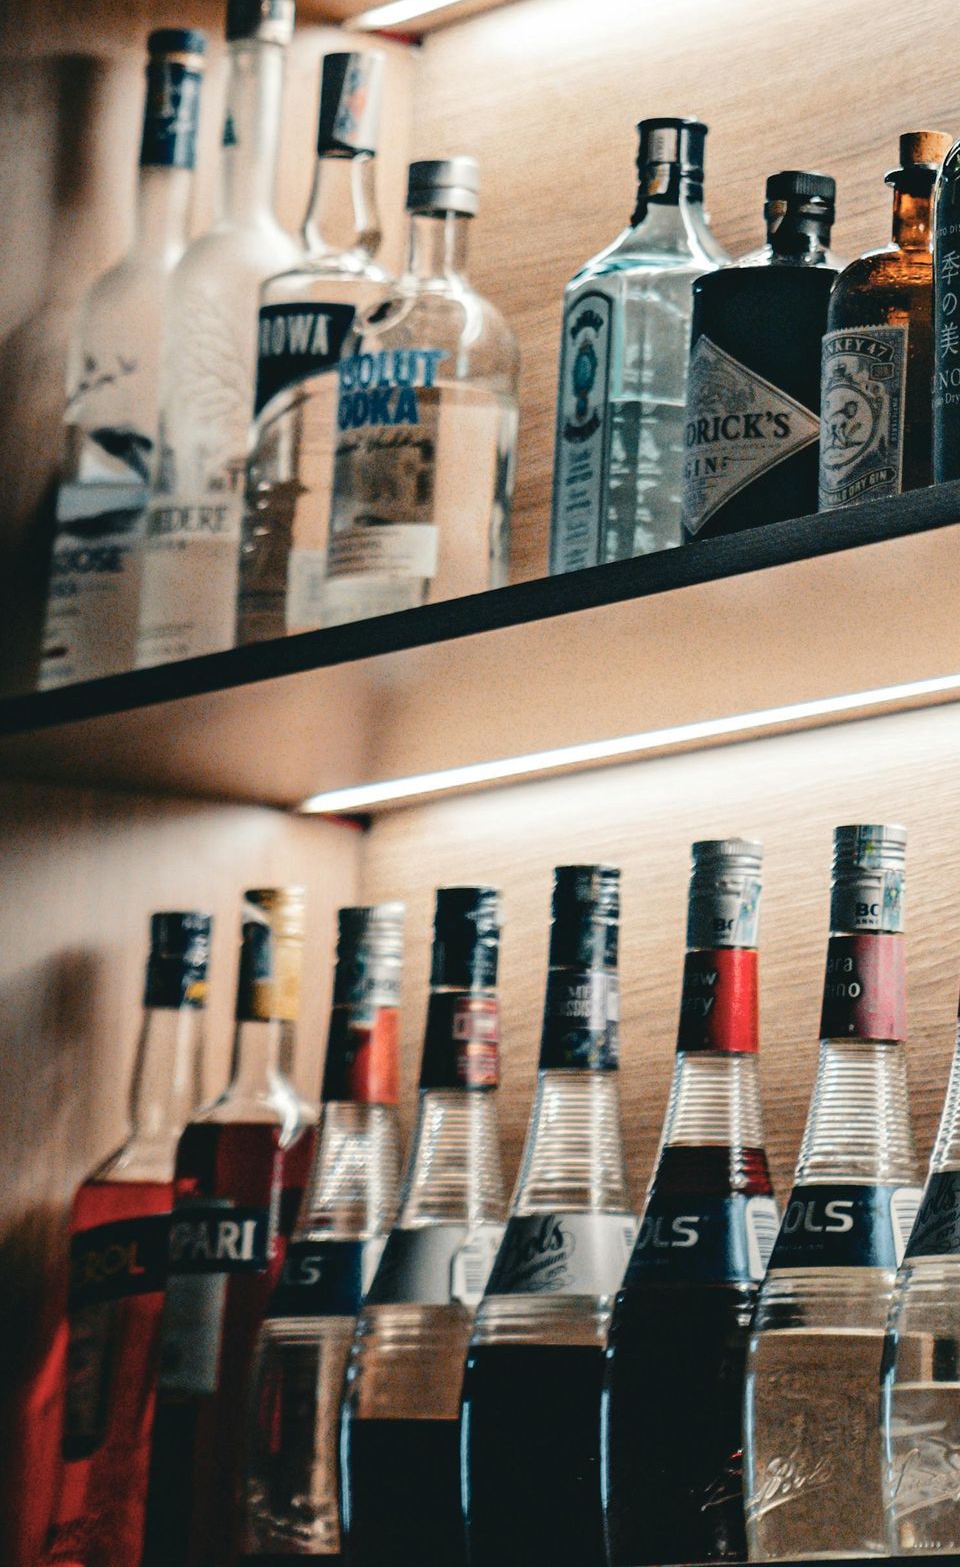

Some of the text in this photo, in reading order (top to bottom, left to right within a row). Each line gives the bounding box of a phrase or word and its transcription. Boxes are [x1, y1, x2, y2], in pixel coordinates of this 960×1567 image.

[866, 343, 888, 358] 47
[945, 391, 960, 405] Dry
[168, 1219, 259, 1261] PARI
